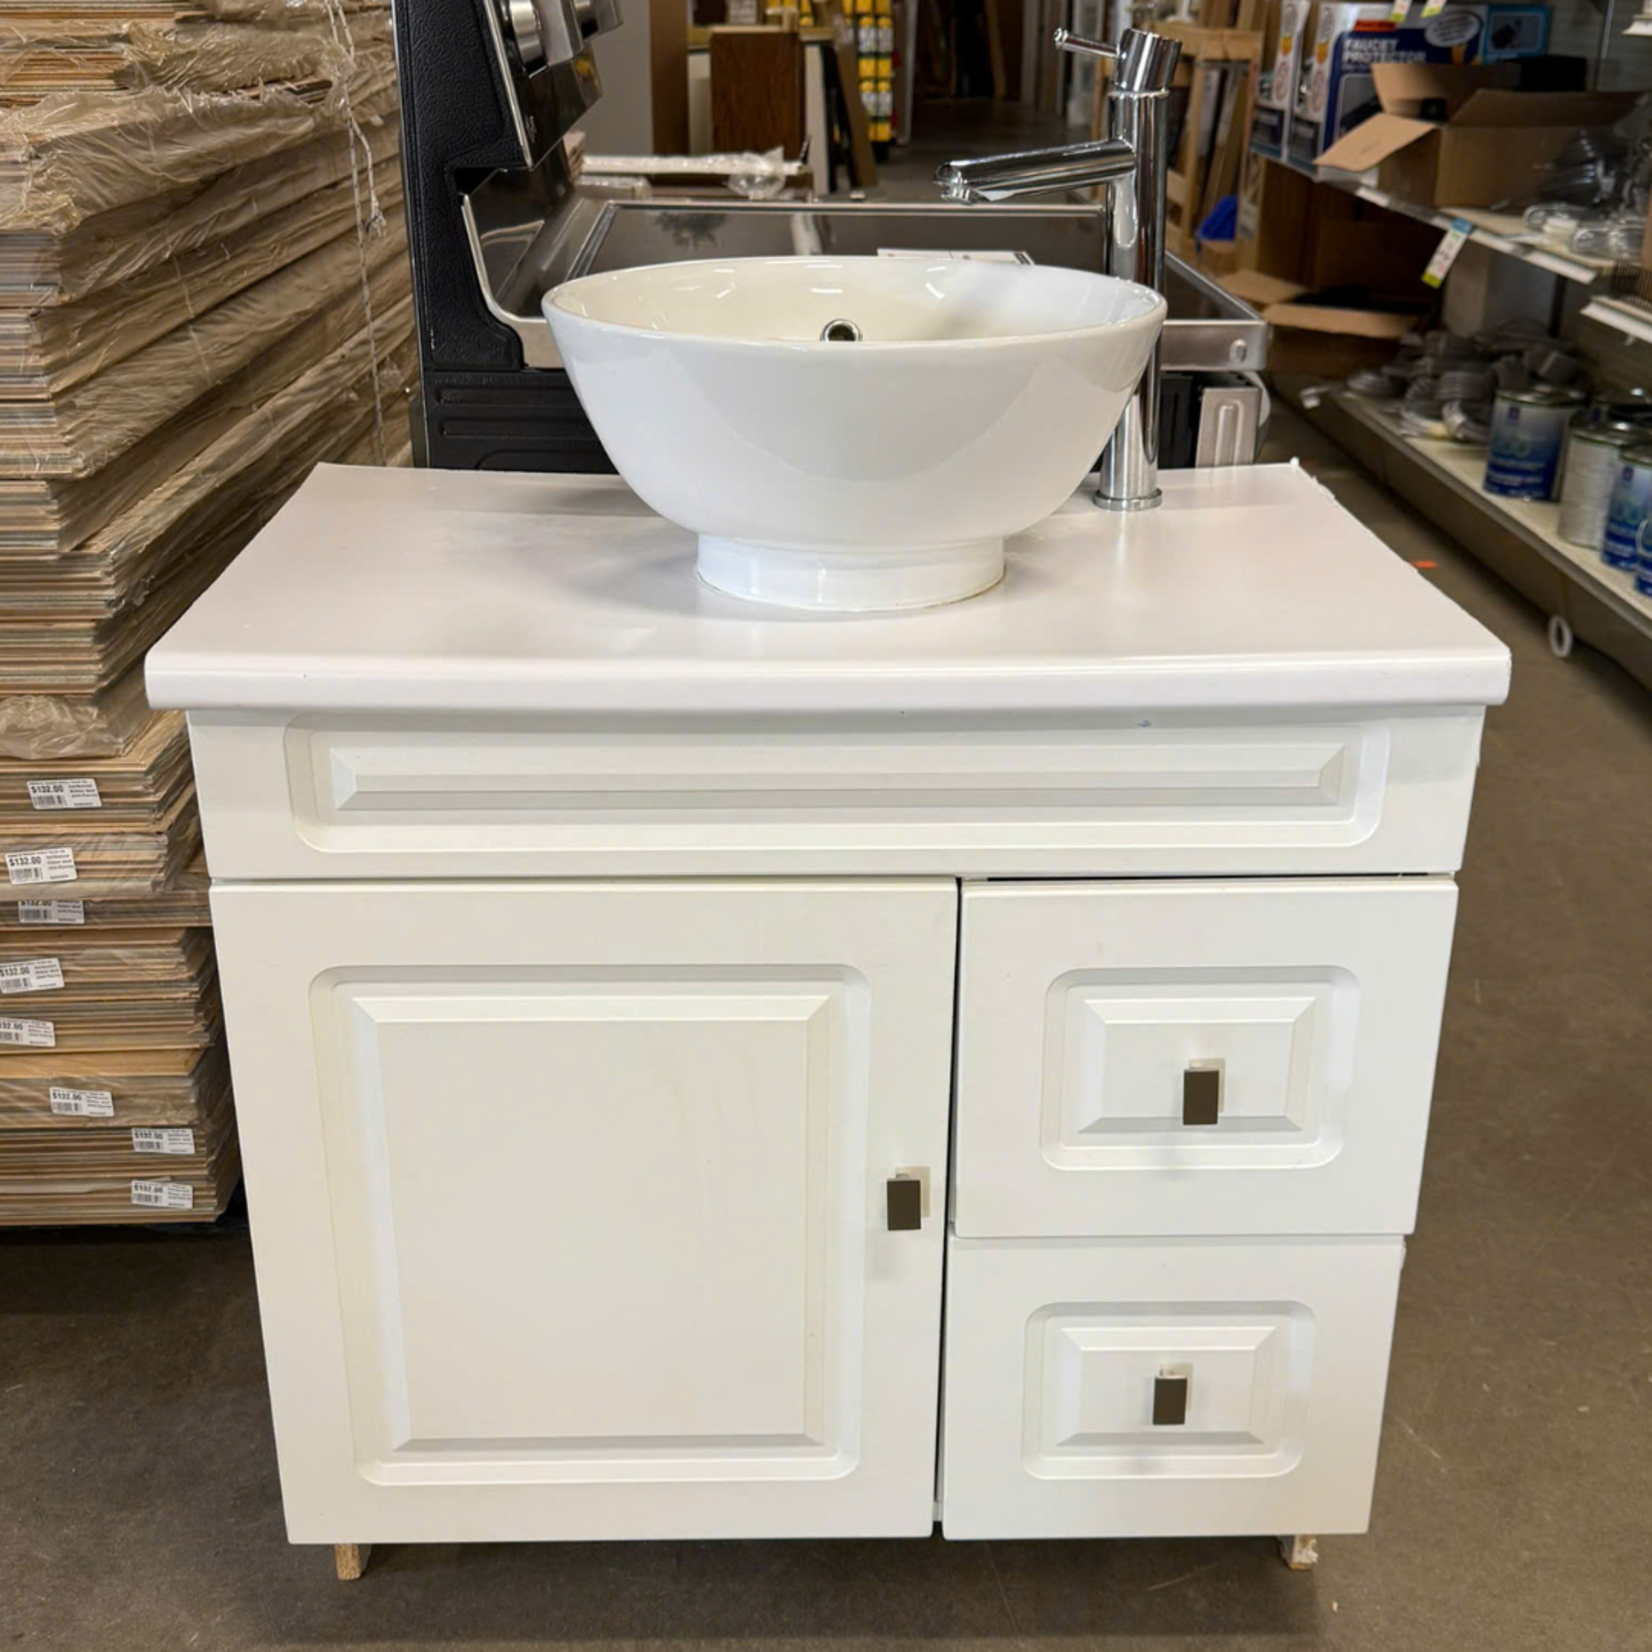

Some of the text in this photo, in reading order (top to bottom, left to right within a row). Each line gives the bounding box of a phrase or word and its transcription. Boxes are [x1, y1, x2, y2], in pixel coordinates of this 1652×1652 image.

[1343, 38, 1397, 53] FAUCET
[1343, 51, 1426, 64] PROTECTOR
[30, 784, 64, 794] $132.00
[9, 856, 42, 867] $132.00
[52, 1091, 82, 1101] $132.00
[134, 1184, 163, 1194] $132.00
